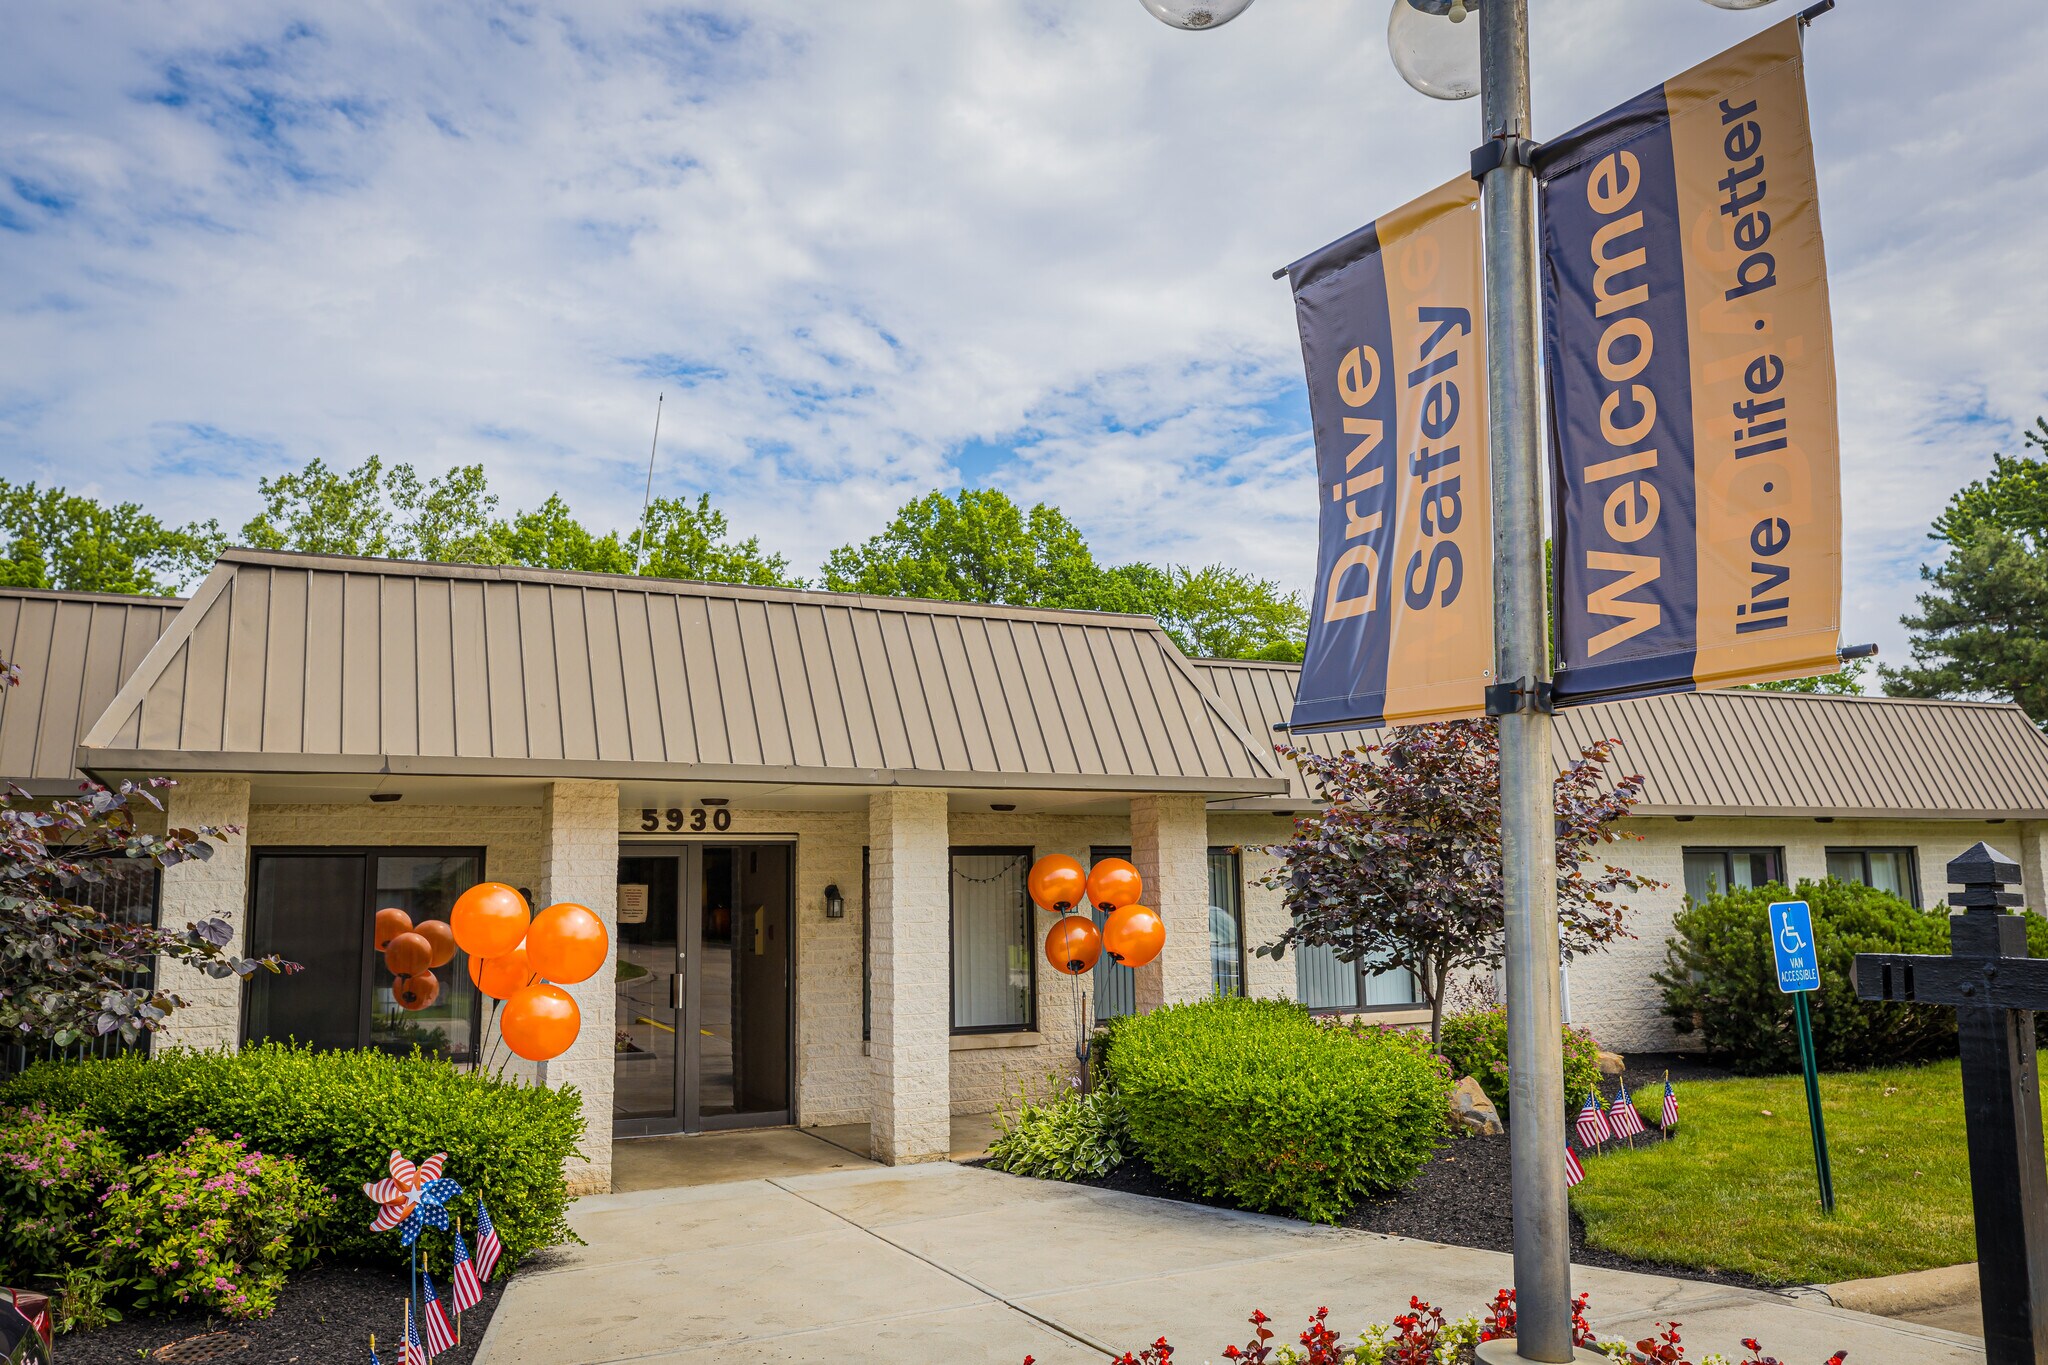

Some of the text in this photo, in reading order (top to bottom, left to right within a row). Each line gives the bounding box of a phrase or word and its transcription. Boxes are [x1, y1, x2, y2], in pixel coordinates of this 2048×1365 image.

[1719, 98, 1777, 302] better
[1404, 305, 1472, 611] Safely
[1584, 149, 1662, 658] Welcome
[1734, 353, 1788, 460] life
[1323, 343, 1383, 624] Drive
[1736, 515, 1791, 634] live
[641, 808, 731, 831] 5930
[1781, 968, 1816, 982] ACCESSIBLE
[1790, 957, 1803, 968] VAN
